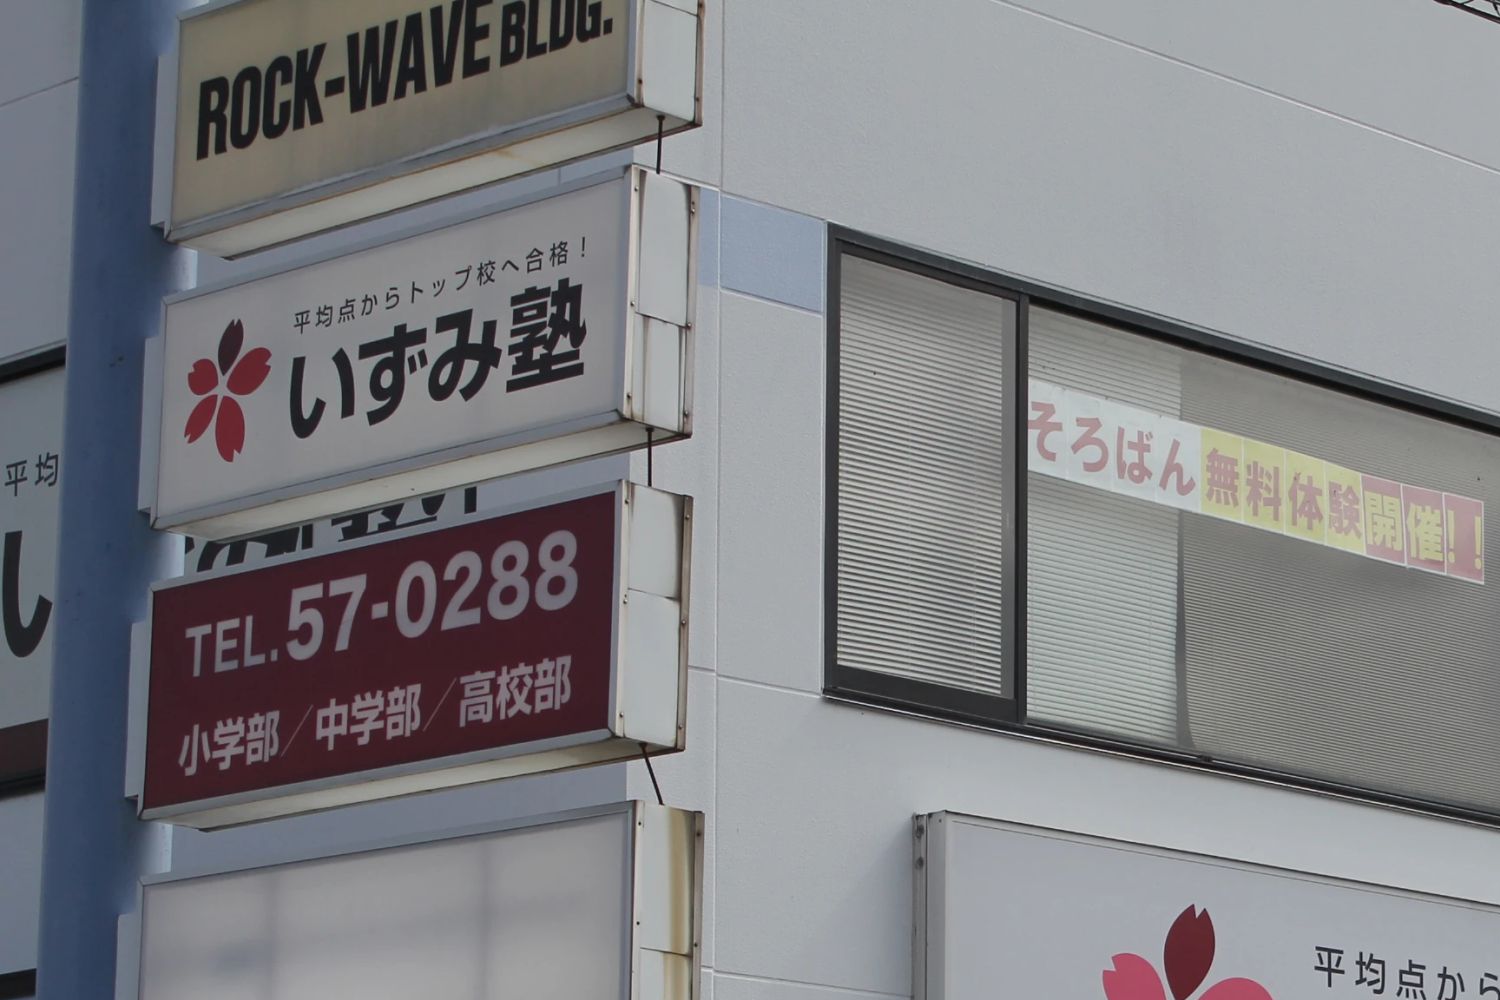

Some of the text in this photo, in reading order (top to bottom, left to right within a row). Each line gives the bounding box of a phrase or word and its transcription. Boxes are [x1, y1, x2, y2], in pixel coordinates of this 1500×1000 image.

[196, 0, 614, 161] ROCK-WAVE BLDG.
[289, 277, 588, 440] いずみ塾
[292, 236, 587, 335] 平均点からトップ校へ合格！
